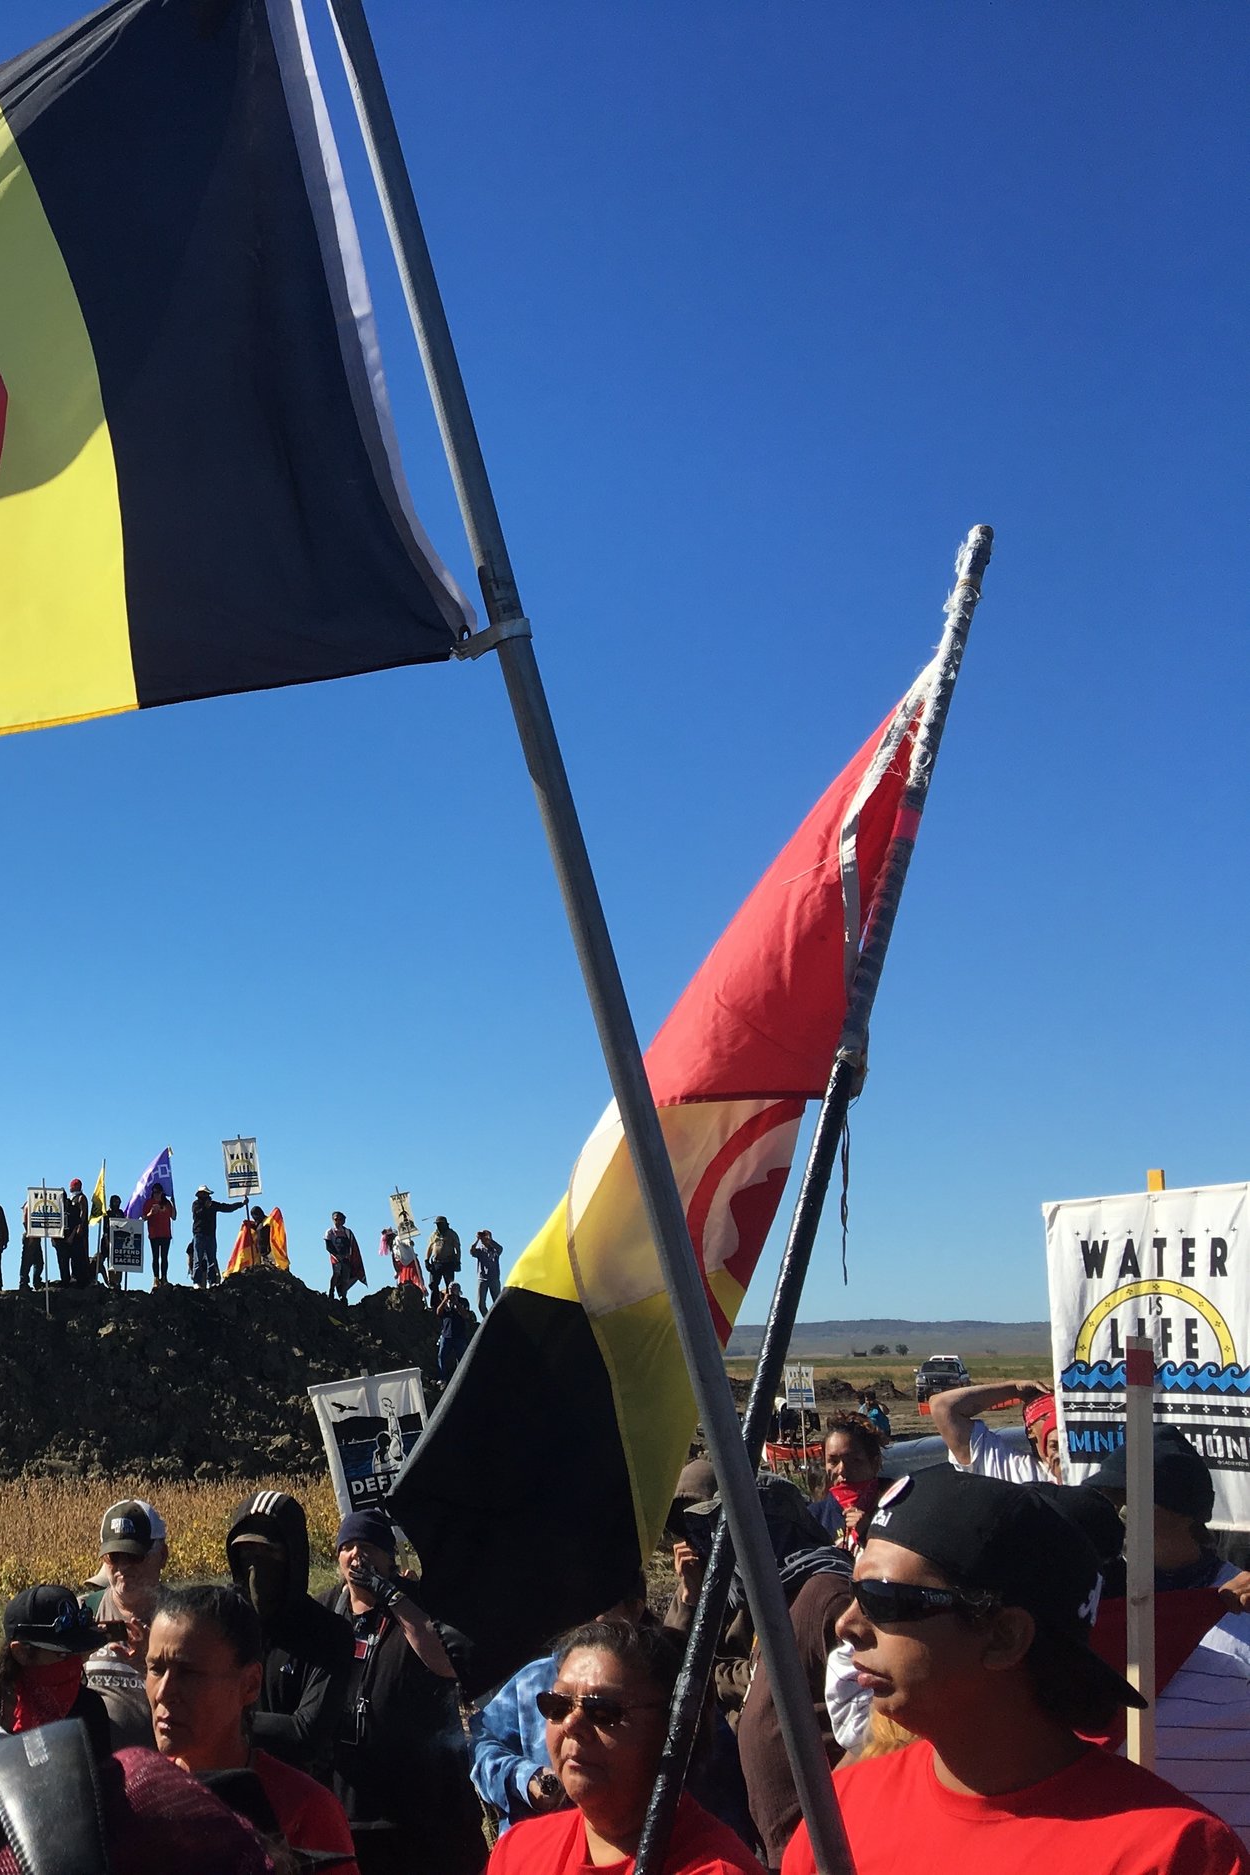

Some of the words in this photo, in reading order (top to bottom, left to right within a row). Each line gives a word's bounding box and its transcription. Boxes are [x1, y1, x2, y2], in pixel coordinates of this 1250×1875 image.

[114, 1248, 140, 1256] DEFEND
[1080, 1237, 1228, 1279] WATER
[1148, 1296, 1163, 1316] IS
[351, 1473, 399, 1496] DEF
[86, 1674, 147, 1690] KEYSTON
